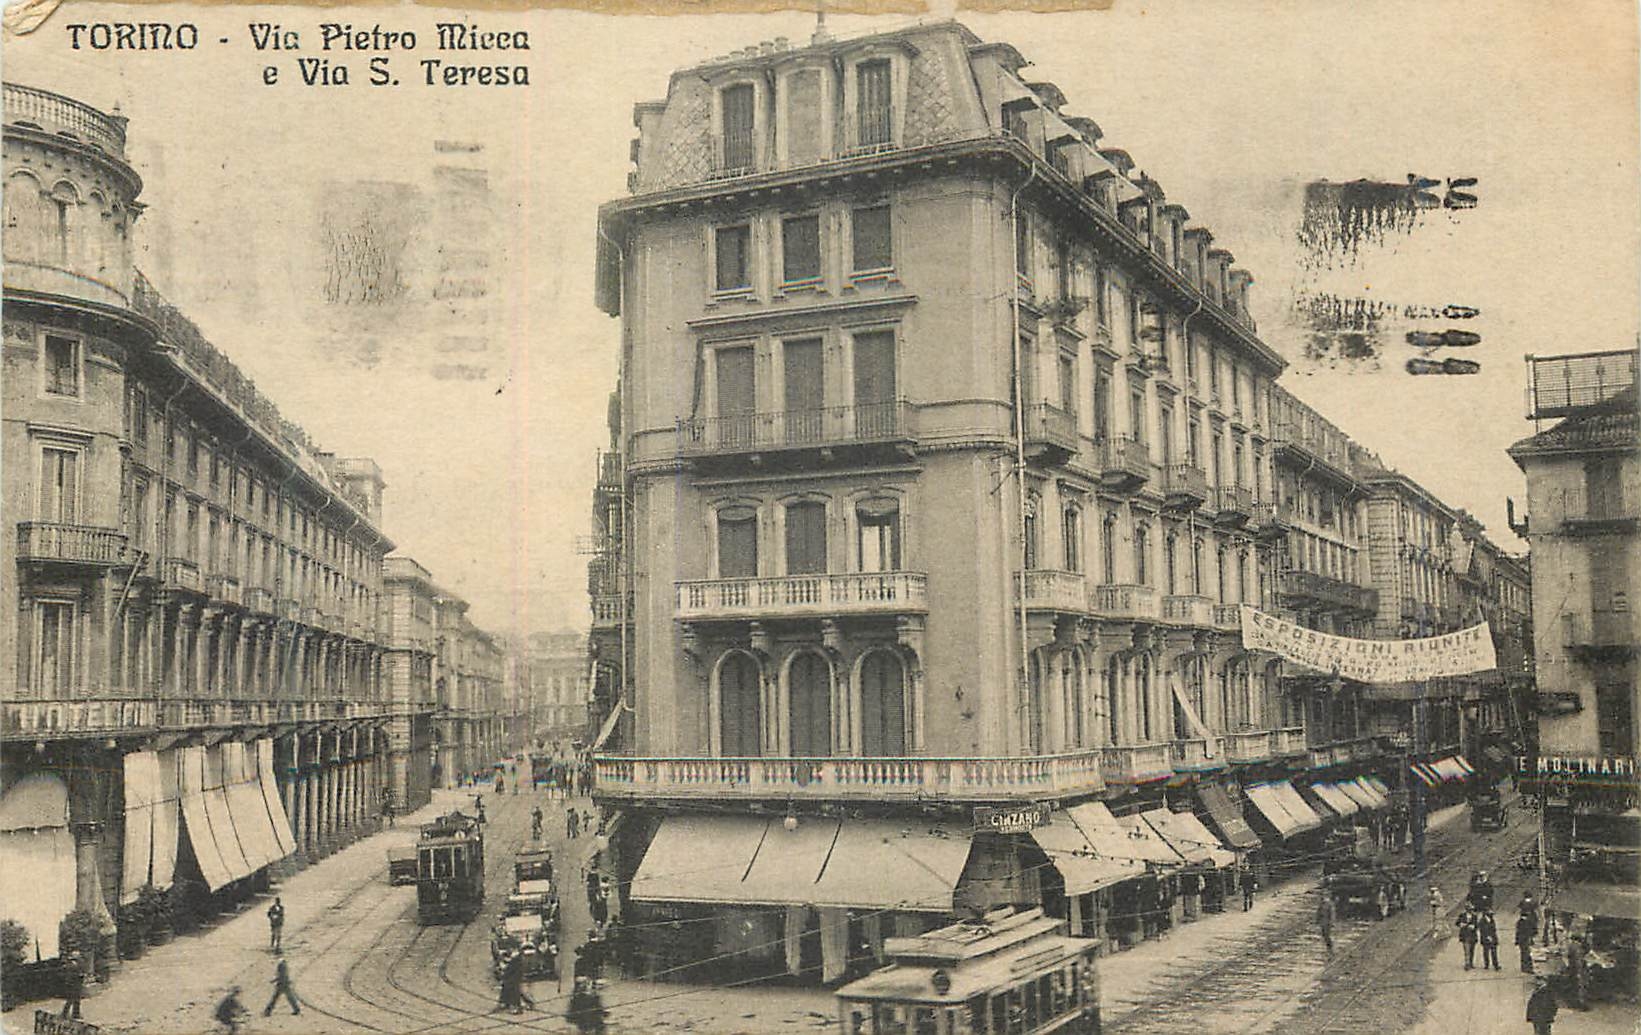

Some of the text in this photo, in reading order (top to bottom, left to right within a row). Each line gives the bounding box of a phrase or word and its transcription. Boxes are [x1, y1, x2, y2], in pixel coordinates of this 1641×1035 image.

[1252, 611, 1480, 655] ESPOSIZIONI RIUNITE
[1537, 756, 1634, 775] MOLINARI
[991, 810, 1041, 827] CINZANO
